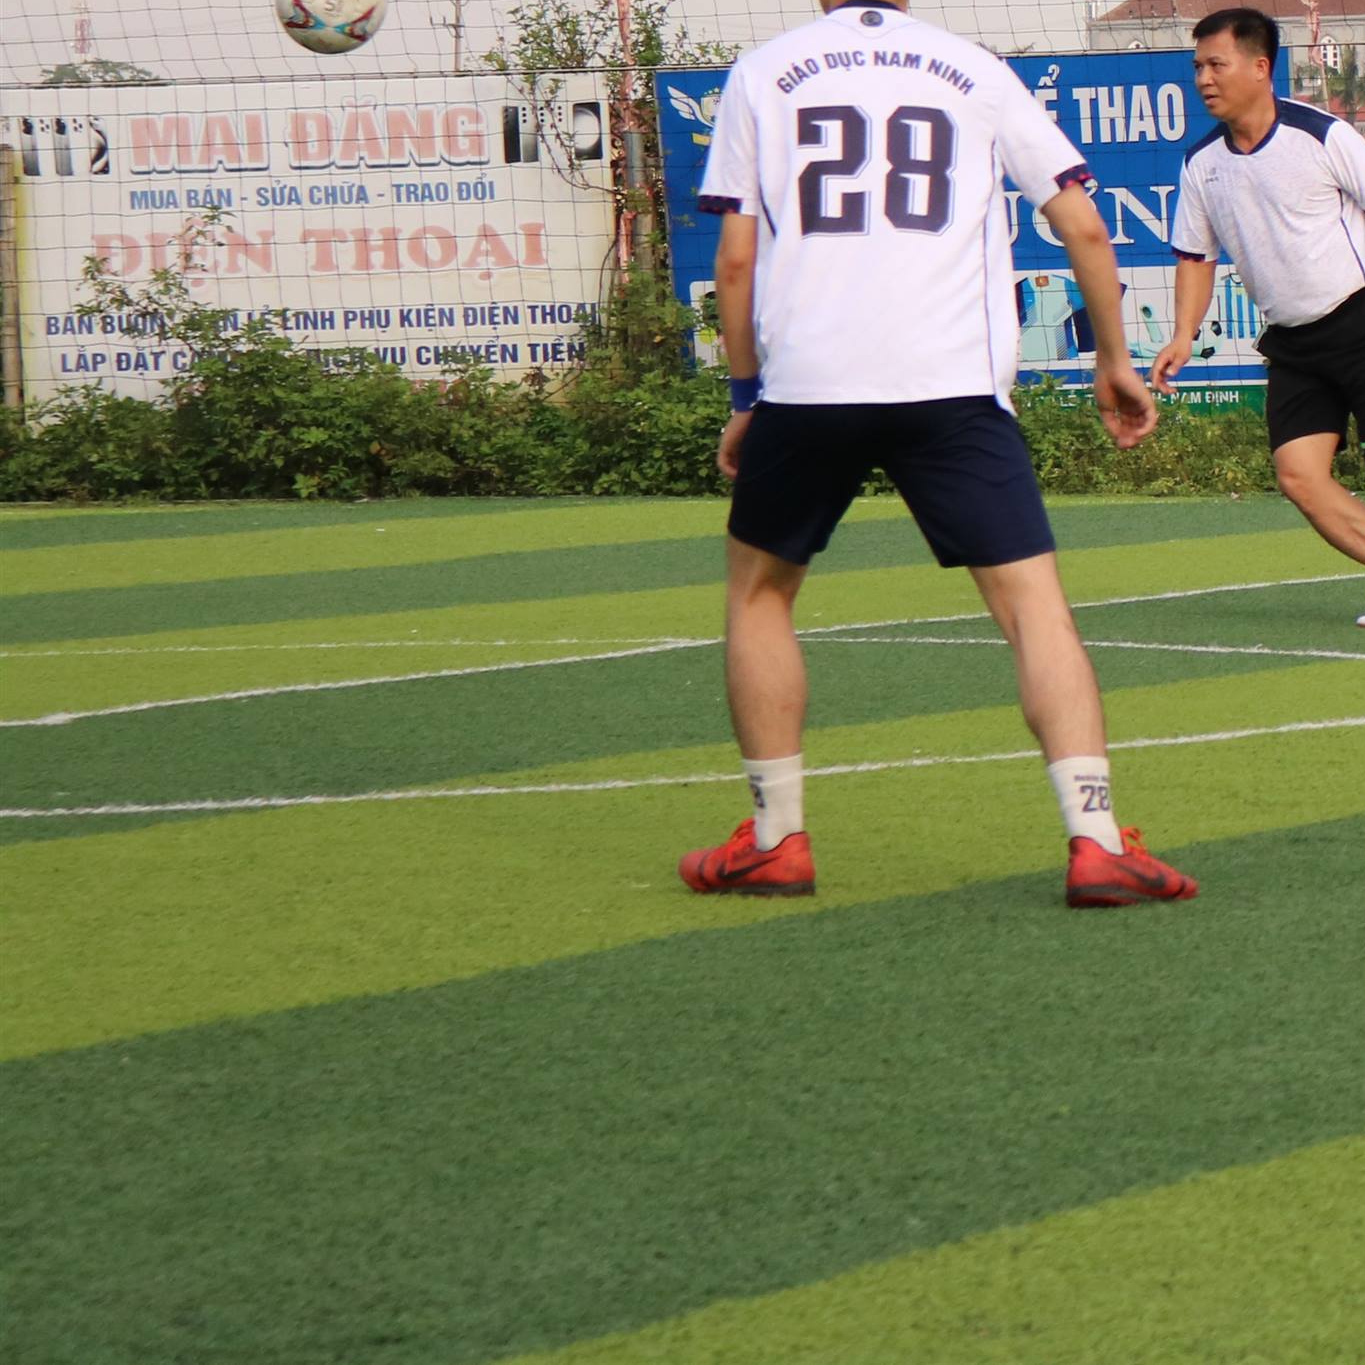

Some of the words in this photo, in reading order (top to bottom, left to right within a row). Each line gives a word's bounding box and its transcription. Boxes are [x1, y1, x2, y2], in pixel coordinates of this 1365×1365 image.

[777, 58, 820, 94] GIÁO
[823, 50, 866, 72] DỤC
[874, 50, 922, 69] NAM
[927, 58, 975, 95] NINH
[1072, 82, 1186, 145] THAO
[130, 112, 267, 170] MAI
[796, 103, 959, 238] 28
[130, 188, 178, 210] MUA
[186, 184, 232, 208] BÁN
[256, 179, 300, 206] SỬA
[309, 180, 370, 205] CHỮA
[392, 182, 449, 203] TRAO
[457, 173, 495, 202] ĐỔI
[91, 217, 276, 288] ĐIỆN
[303, 222, 547, 281] THOẠI
[344, 309, 390, 333] PHỤ
[400, 303, 454, 332] KIỆN
[463, 302, 519, 330] ĐIỆN
[61, 345, 106, 372] LẮP
[1205, 390, 1239, 406] ĐỊNH
[1080, 784, 1110, 812] 28
